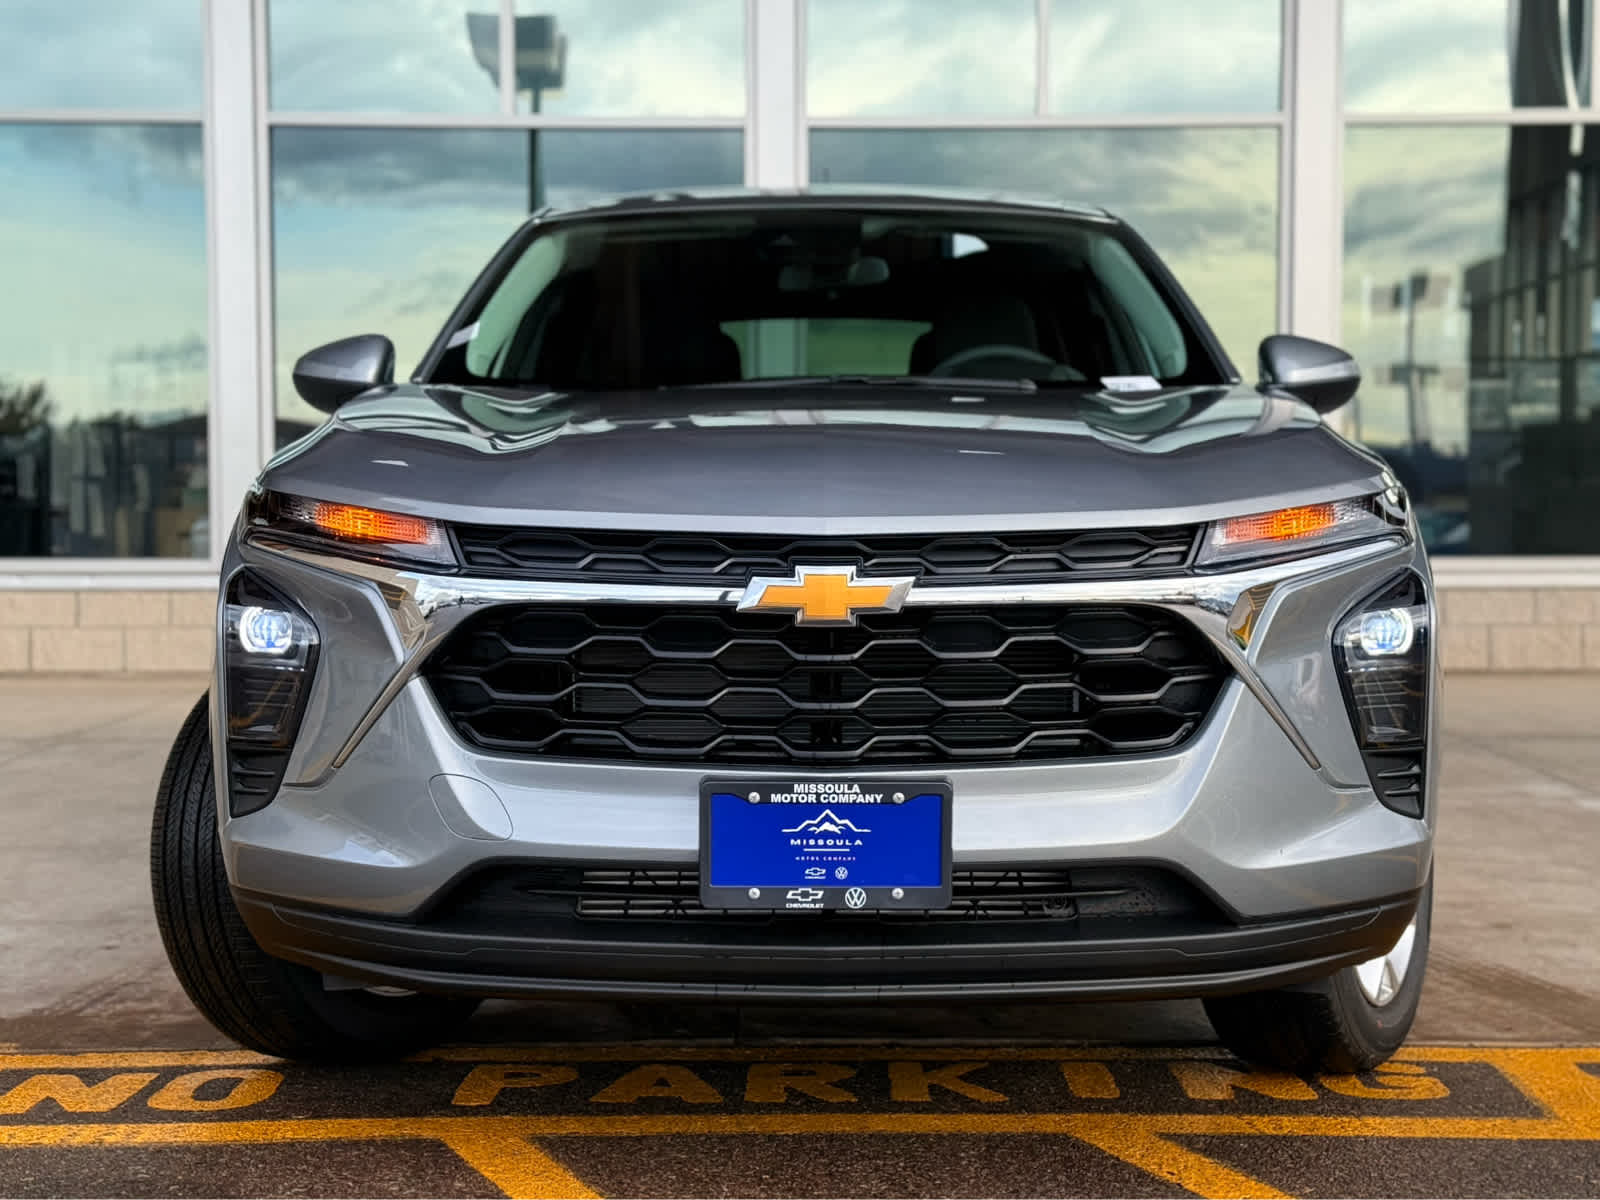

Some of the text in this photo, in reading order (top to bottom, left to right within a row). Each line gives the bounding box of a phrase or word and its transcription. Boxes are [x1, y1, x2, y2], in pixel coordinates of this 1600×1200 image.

[793, 783, 861, 794] MISSOULA
[770, 793, 884, 804] MOTOR COMPANY
[790, 838, 863, 846] MISSOULA
[0, 1061, 1451, 1115] NO PARKING
